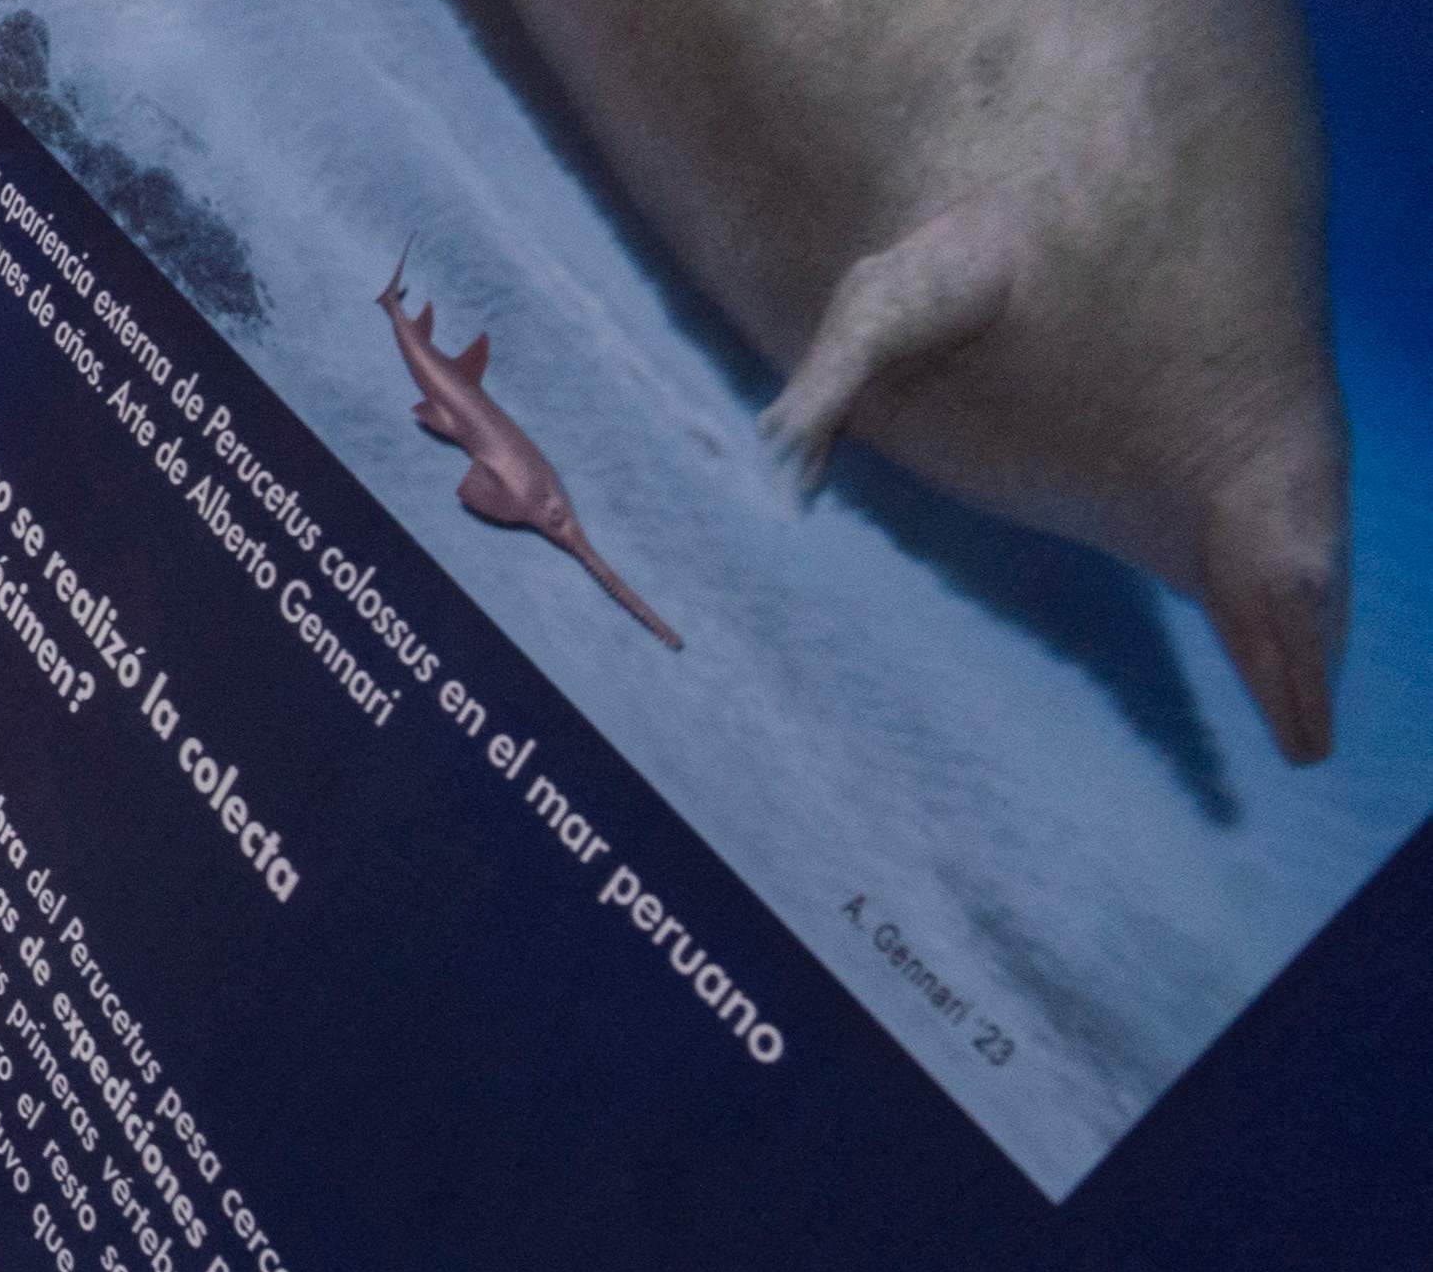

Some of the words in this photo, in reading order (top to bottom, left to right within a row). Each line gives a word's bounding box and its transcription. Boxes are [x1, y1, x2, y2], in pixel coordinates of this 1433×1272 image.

[26, 282, 56, 328] de
[52, 319, 104, 393] años.
[104, 379, 156, 448] Arte
[153, 435, 188, 486] de
[183, 474, 277, 590] Alberto
[278, 578, 402, 727] Gennari
[9, 505, 45, 558] se
[41, 548, 147, 689] realizó
[139, 670, 181, 741] la
[177, 735, 300, 904] colecta
[92, 288, 173, 386] externa
[169, 371, 205, 422] de
[201, 403, 322, 552] Perucetus
[318, 545, 441, 683] colossus
[438, 678, 487, 737] en
[486, 732, 537, 780] el
[524, 774, 611, 864] mar
[597, 864, 784, 1064] peruano
[4, 998, 100, 1153] primeras
[15, 1091, 47, 1130] el
[40, 1138, 97, 1232] resto
[17, 934, 51, 988] de
[51, 990, 208, 1249] expediciones
[24, 866, 68, 925] del
[57, 915, 162, 1085] Perucetus
[153, 1085, 223, 1184] pesa
